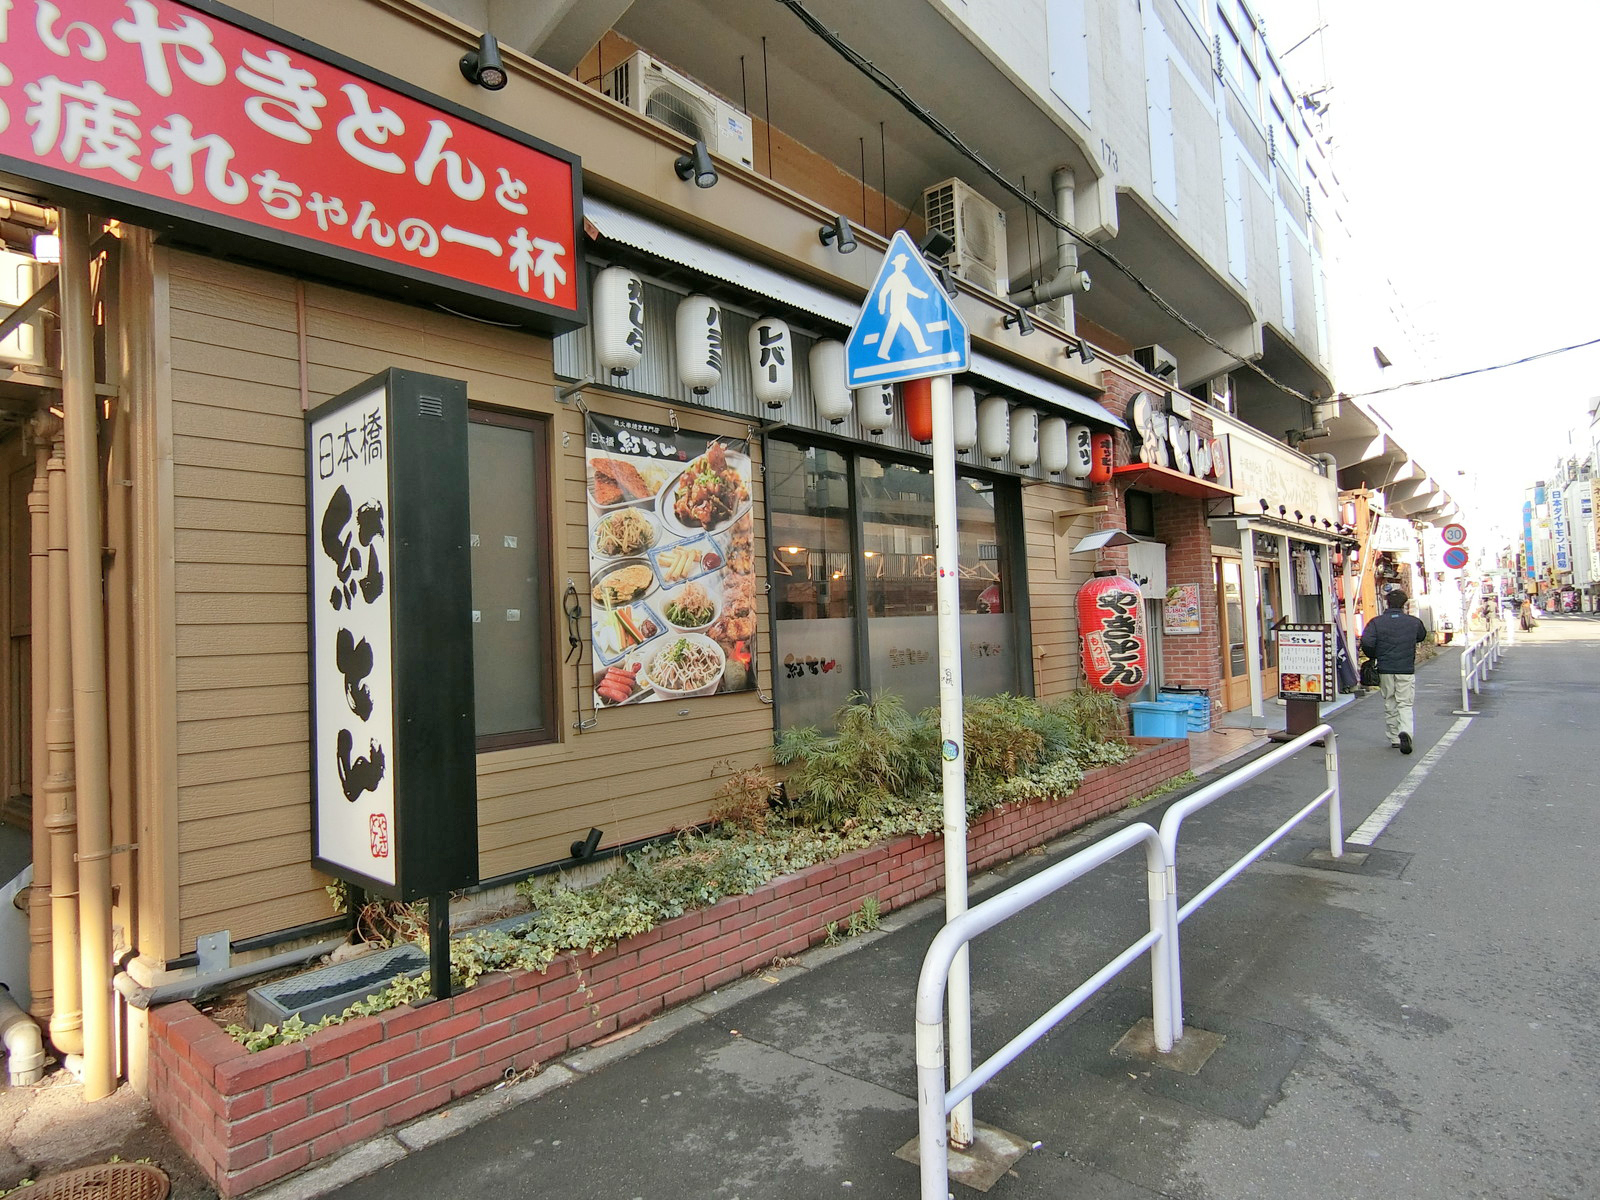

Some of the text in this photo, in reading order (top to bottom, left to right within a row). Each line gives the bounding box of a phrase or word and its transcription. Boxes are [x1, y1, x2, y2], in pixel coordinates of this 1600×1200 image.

[0, 62, 567, 299] 疲れちゃんの一杯
[1101, 139, 1118, 173] 173
[757, 326, 785, 383] レバー
[319, 406, 383, 481] 日本橋
[591, 432, 614, 447] 日本橋
[618, 430, 677, 456] 紅とん
[1447, 529, 1462, 541] 30
[321, 484, 385, 803] 紅とん
[784, 653, 836, 678] 紅とん
[1098, 592, 1143, 686] やきとん
